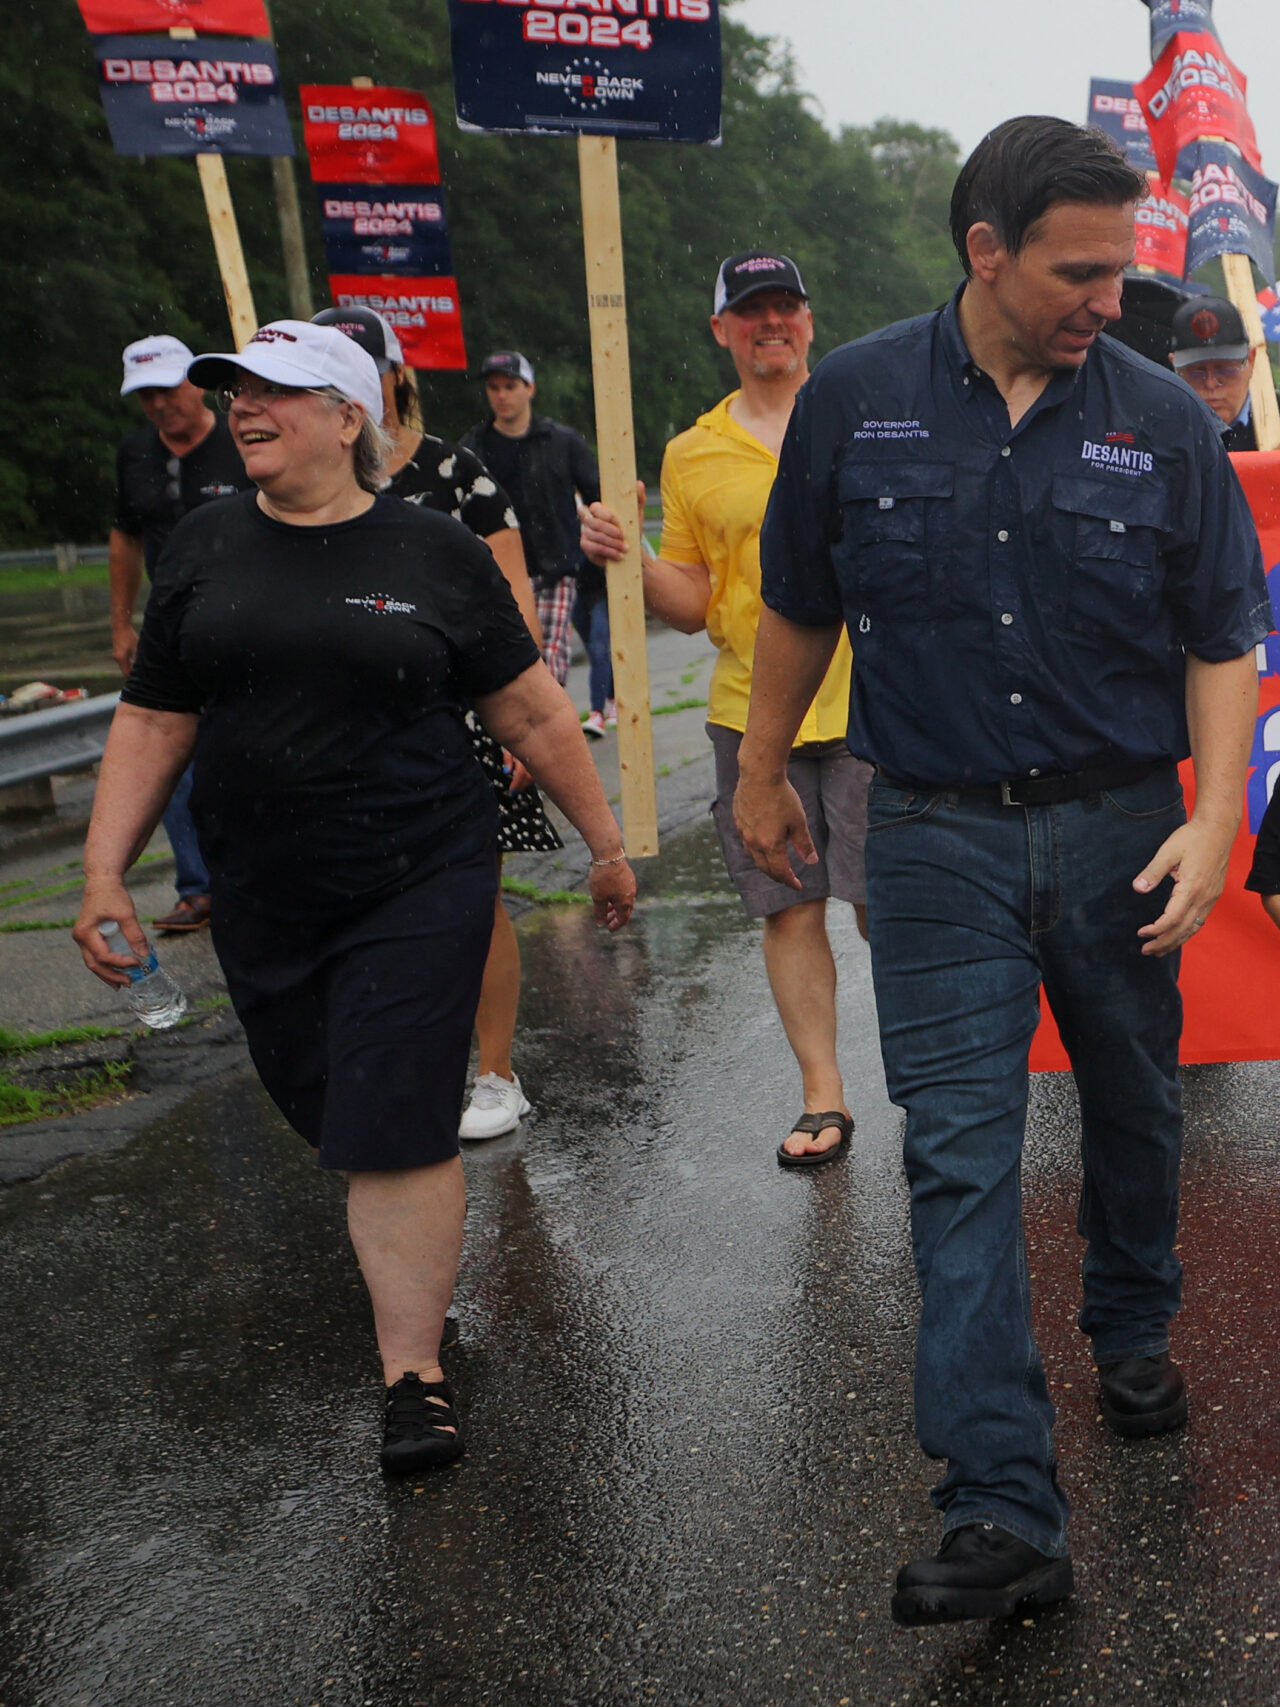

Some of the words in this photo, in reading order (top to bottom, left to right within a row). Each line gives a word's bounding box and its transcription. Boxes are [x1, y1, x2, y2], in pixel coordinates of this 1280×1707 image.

[523, 10, 652, 50] 2024
[103, 58, 274, 85] DESANTIS
[536, 71, 593, 87] NEVER
[597, 76, 643, 90] BACK
[151, 81, 238, 104] 2024
[582, 86, 634, 100] DOWN
[307, 104, 429, 126] DESANTIS
[338, 123, 399, 142] 2024
[324, 199, 443, 222] DESANTIS
[353, 216, 415, 237] 2024
[853, 431, 875, 440] RON
[876, 430, 930, 439] DESANTIS
[862, 420, 920, 430] GOVERNOR
[1081, 440, 1154, 473] DESANTIS
[1090, 461, 1105, 470] FOR
[1105, 465, 1143, 477] PRESIDENT
